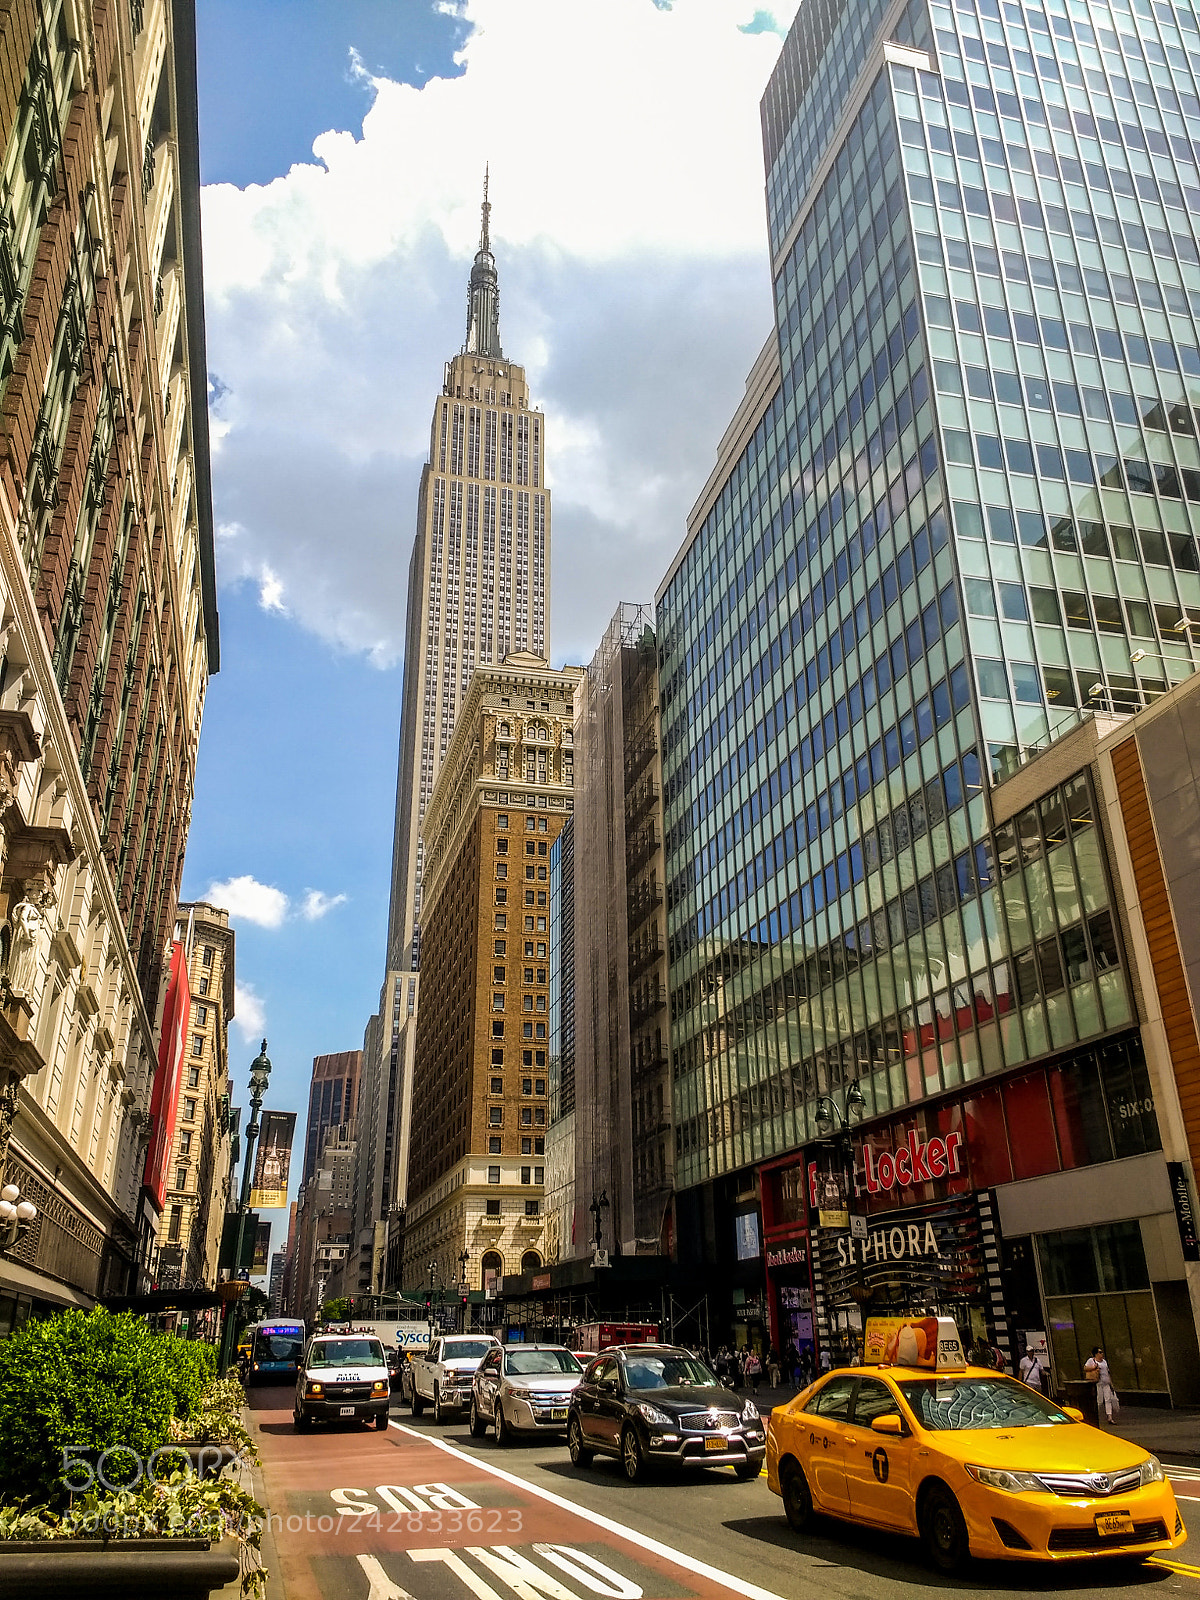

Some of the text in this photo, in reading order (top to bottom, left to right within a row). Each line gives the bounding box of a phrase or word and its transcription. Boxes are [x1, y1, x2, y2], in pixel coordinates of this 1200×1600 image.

[1119, 1098, 1154, 1118] SIX:0
[863, 1129, 962, 1193] Locker
[837, 1221, 939, 1267] SEPHORA
[395, 1330, 430, 1345] Sysco
[939, 1341, 958, 1351] 8E65
[330, 1482, 482, 1517] BUS
